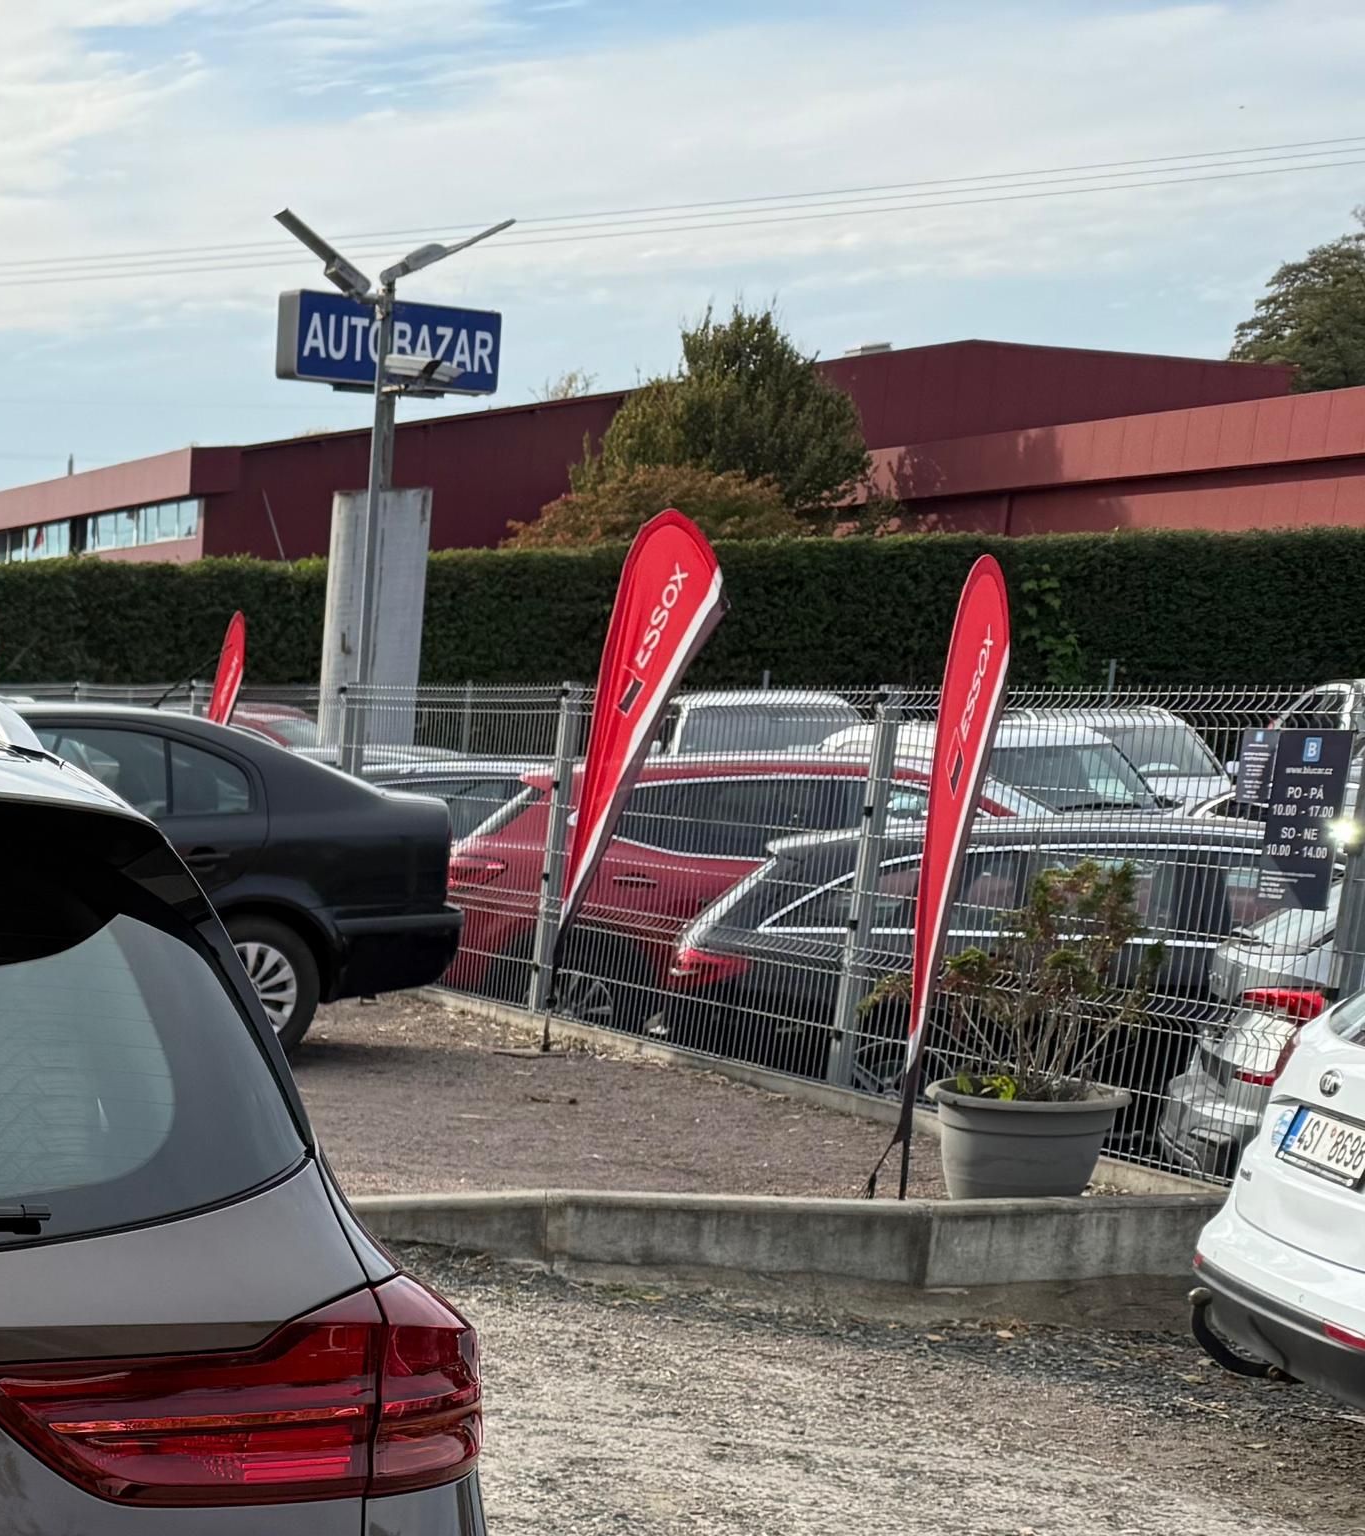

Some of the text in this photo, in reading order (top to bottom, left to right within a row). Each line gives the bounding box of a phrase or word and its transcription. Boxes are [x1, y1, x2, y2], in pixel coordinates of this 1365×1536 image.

[302, 312, 494, 375] AUTOBAZAR
[635, 562, 689, 669] ESSOX
[961, 624, 994, 742] ESSOX
[1307, 742, 1318, 757] B
[1287, 786, 1302, 799] PO
[1309, 784, 1324, 799] PÁ
[1272, 803, 1297, 816] 10.00
[1309, 805, 1334, 818] 17.00
[1280, 826, 1296, 839] SO
[1303, 828, 1319, 840] NE
[1267, 843, 1291, 856] 10.00
[1302, 846, 1328, 859] 14.00
